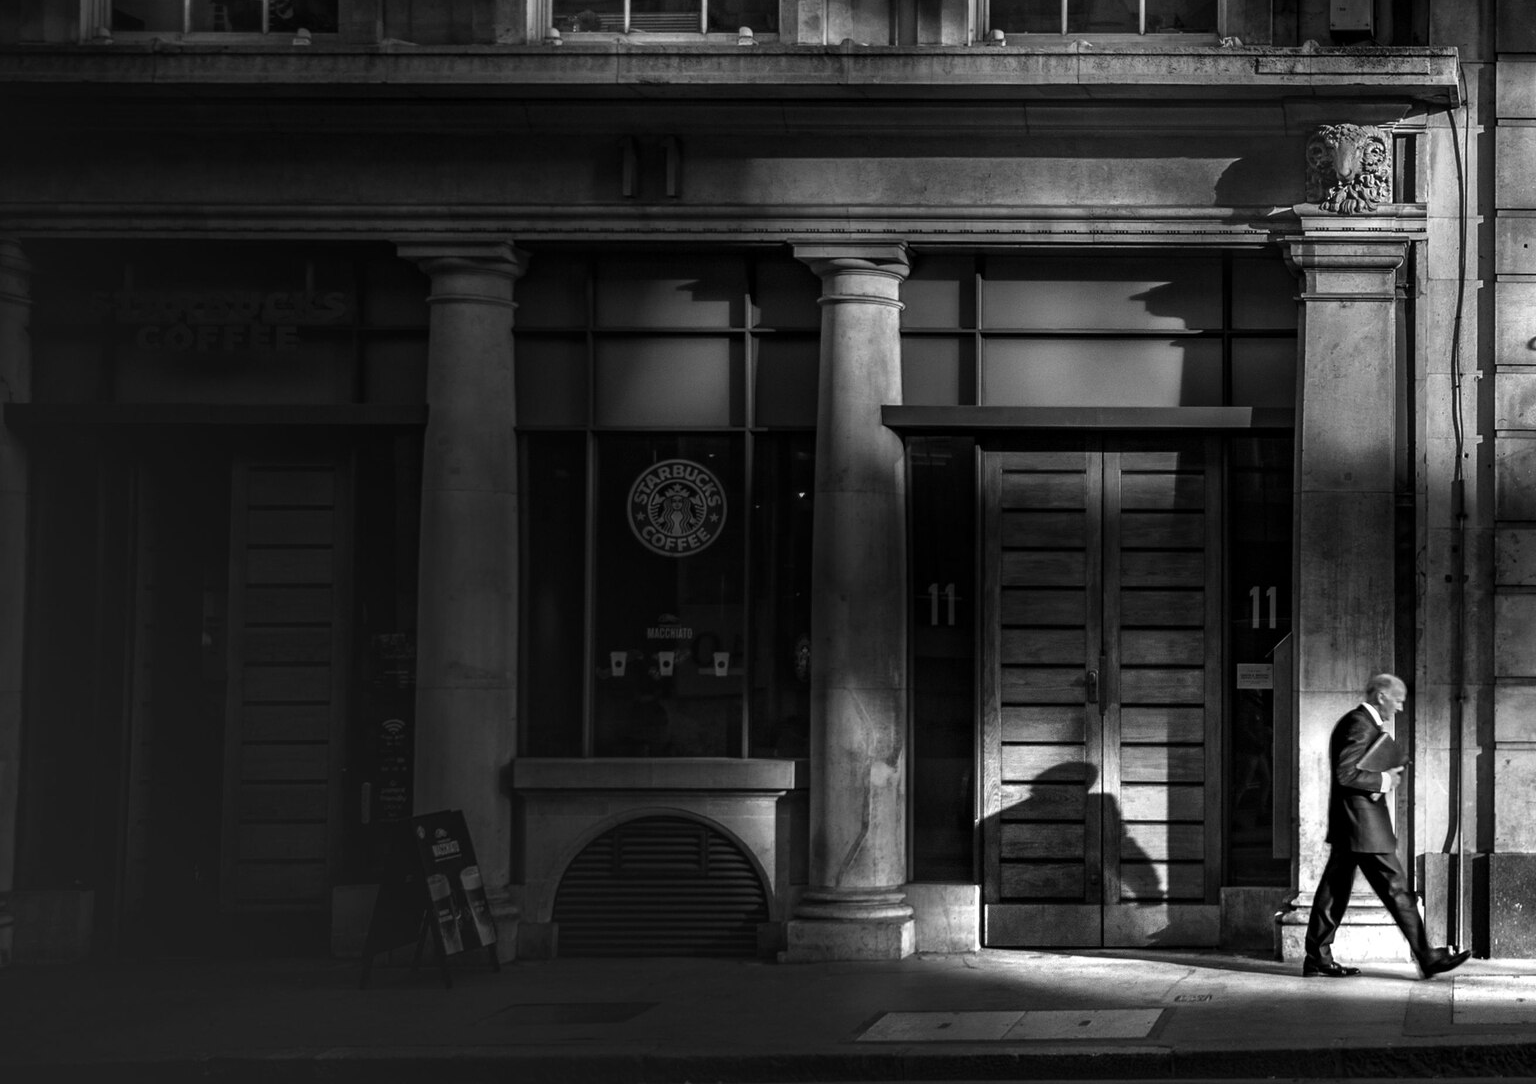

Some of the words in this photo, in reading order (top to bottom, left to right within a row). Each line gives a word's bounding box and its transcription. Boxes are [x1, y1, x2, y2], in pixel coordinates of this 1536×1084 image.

[136, 324, 299, 351] COFFEE
[634, 464, 721, 507] STARBUCKS
[642, 526, 711, 551] COFFEE
[928, 582, 955, 626] 11
[1249, 586, 1277, 629] 11
[647, 627, 693, 639] MACCHIATO
